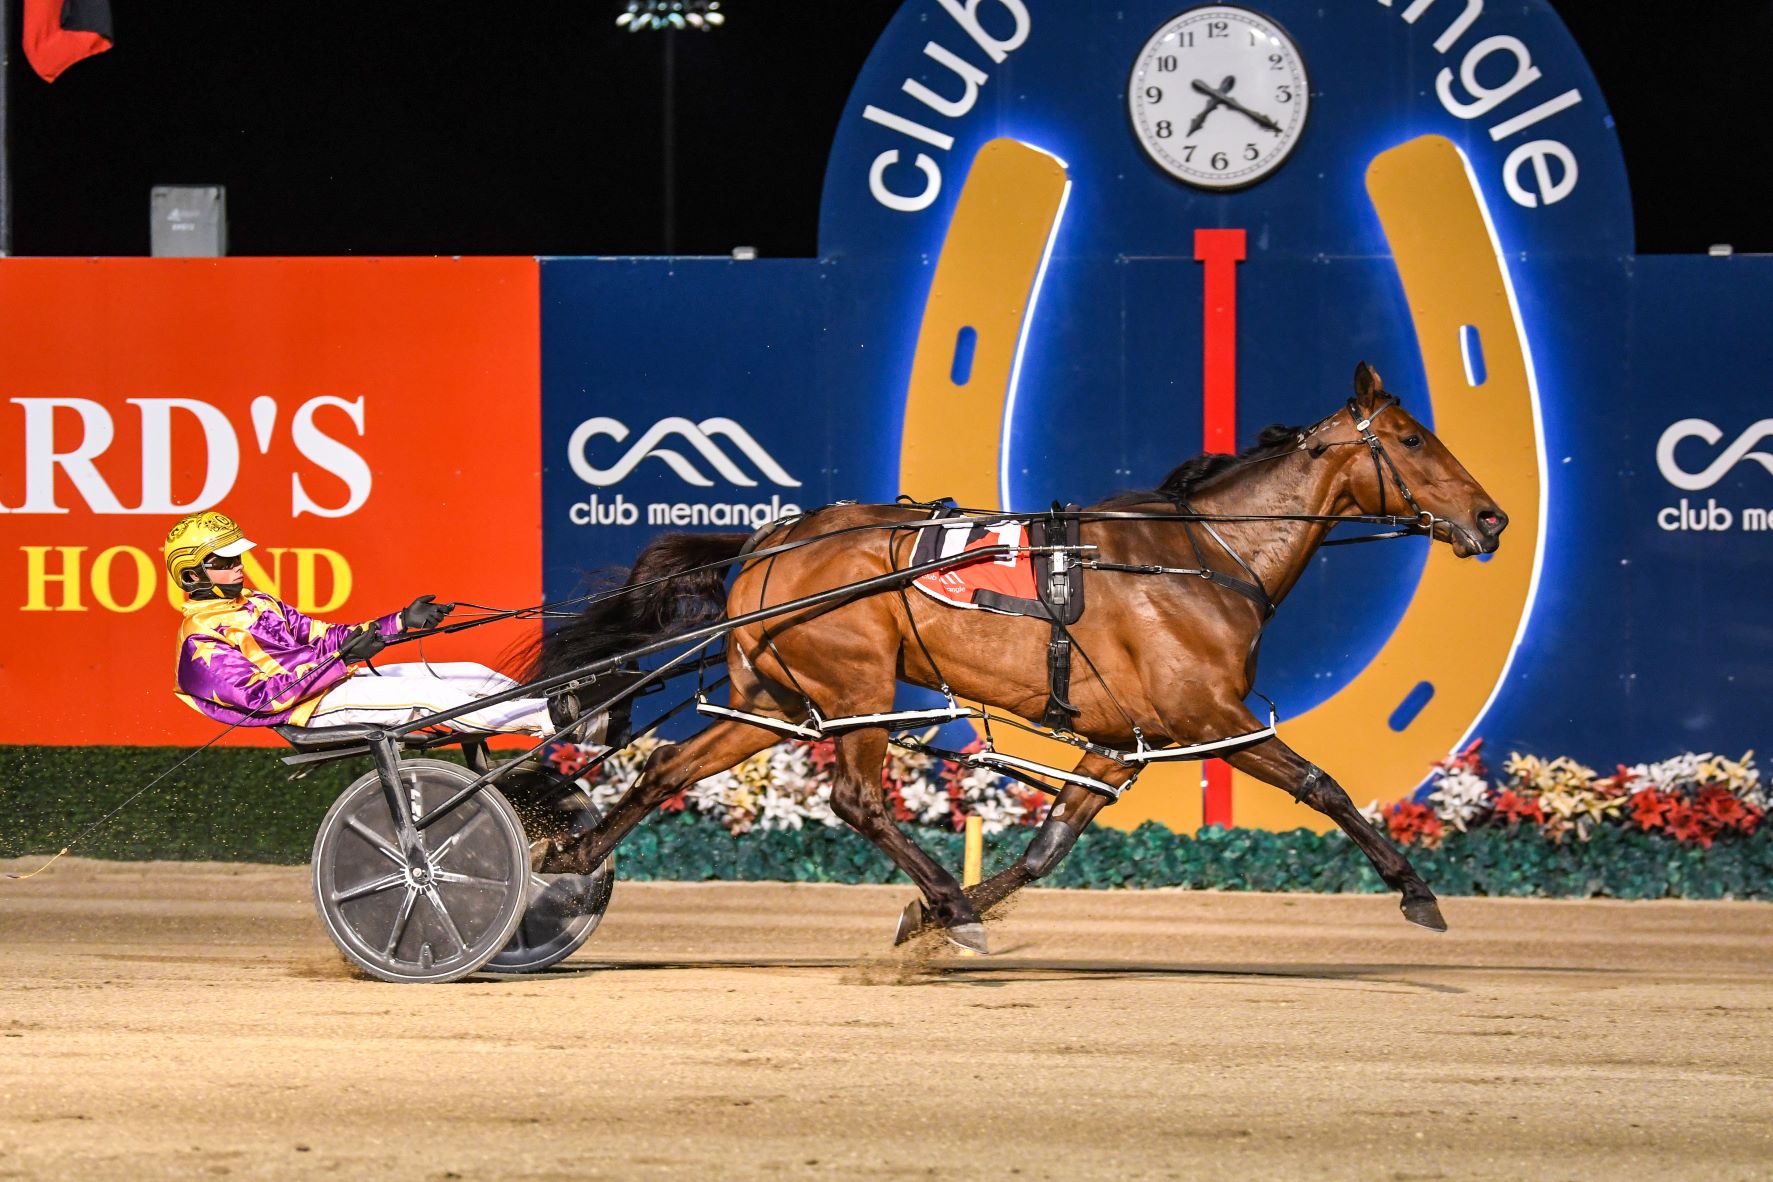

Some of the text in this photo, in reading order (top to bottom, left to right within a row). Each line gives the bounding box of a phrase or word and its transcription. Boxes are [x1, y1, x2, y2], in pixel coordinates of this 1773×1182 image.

[1206, 21, 1229, 38] 12
[1178, 31, 1194, 47] 11
[1157, 55, 1177, 72] 10
[1268, 53, 1284, 70] 2
[1145, 86, 1163, 104] 9
[1275, 85, 1292, 104] 3
[862, 0, 1583, 212] club ngle
[1155, 120, 1173, 139] 8
[1182, 145, 1198, 163] 7
[1210, 152, 1229, 170] 6
[1243, 143, 1260, 161] 5
[0, 395, 373, 518] RD'S
[569, 494, 639, 525] club
[1657, 498, 1734, 531] club
